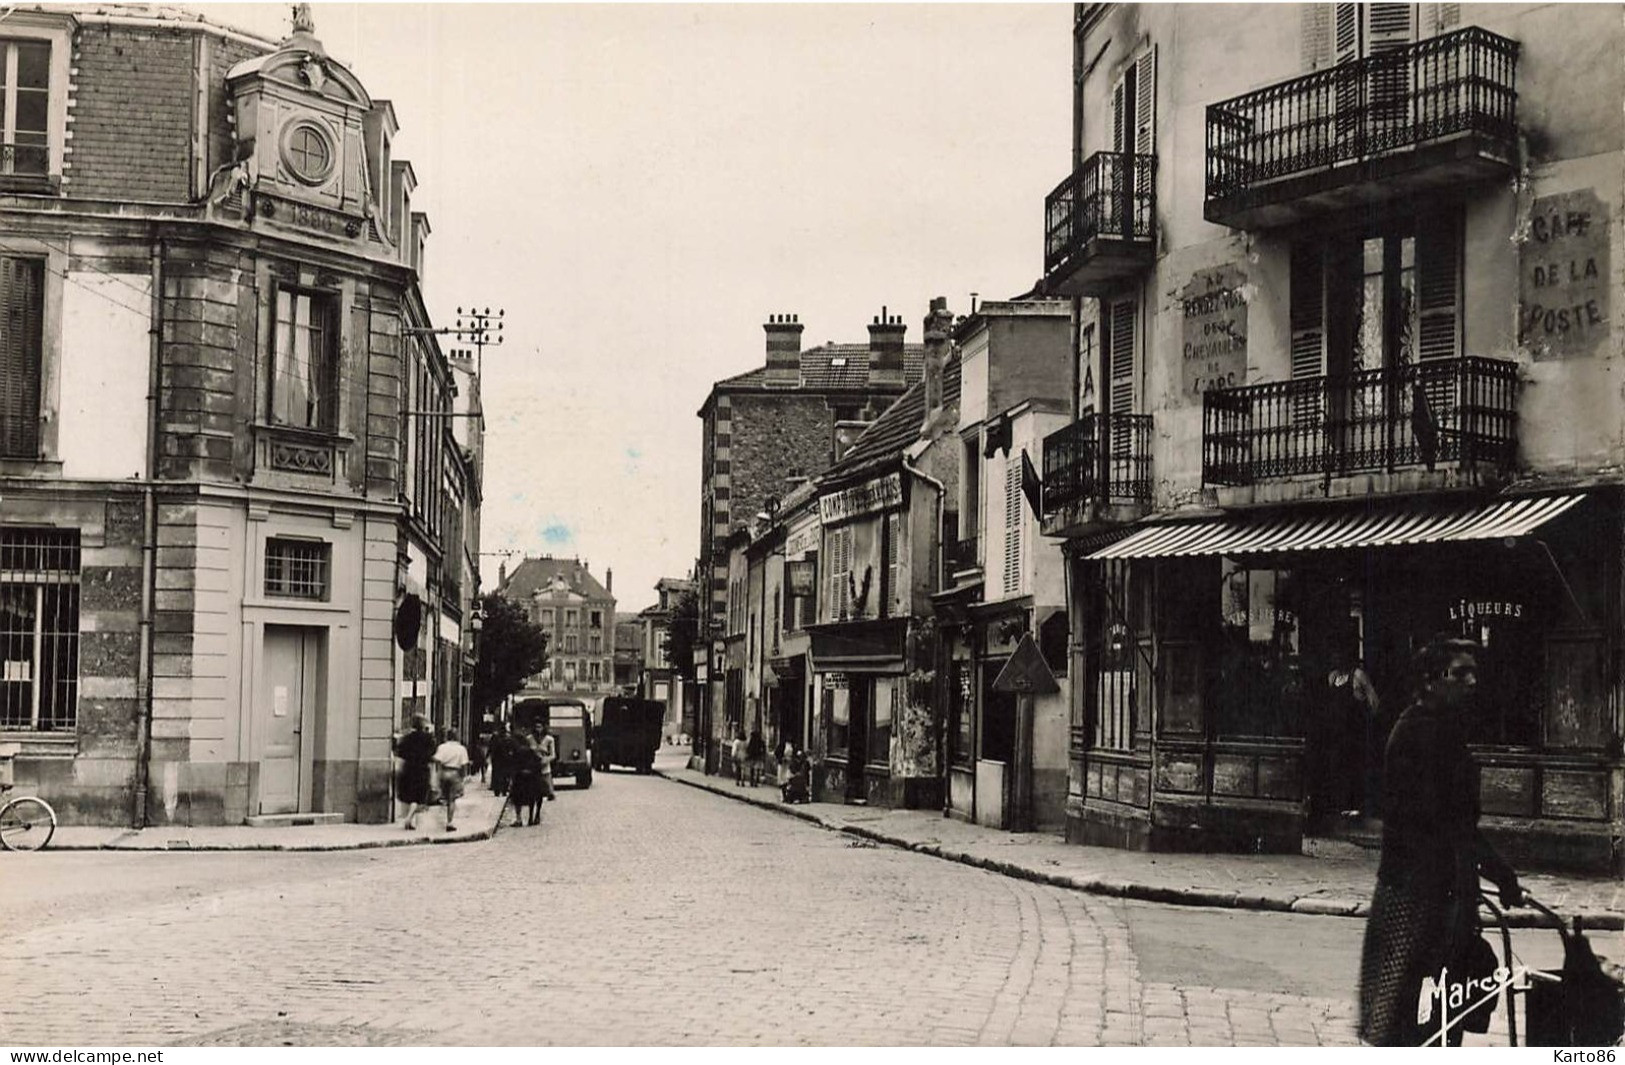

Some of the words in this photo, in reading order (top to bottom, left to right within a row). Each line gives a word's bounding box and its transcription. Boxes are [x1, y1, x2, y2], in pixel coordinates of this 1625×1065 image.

[1534, 264, 1559, 288] DE
[1570, 258, 1598, 281] LA
[1529, 300, 1601, 333] POSTE
[1449, 599, 1522, 619] LIQUEURS
